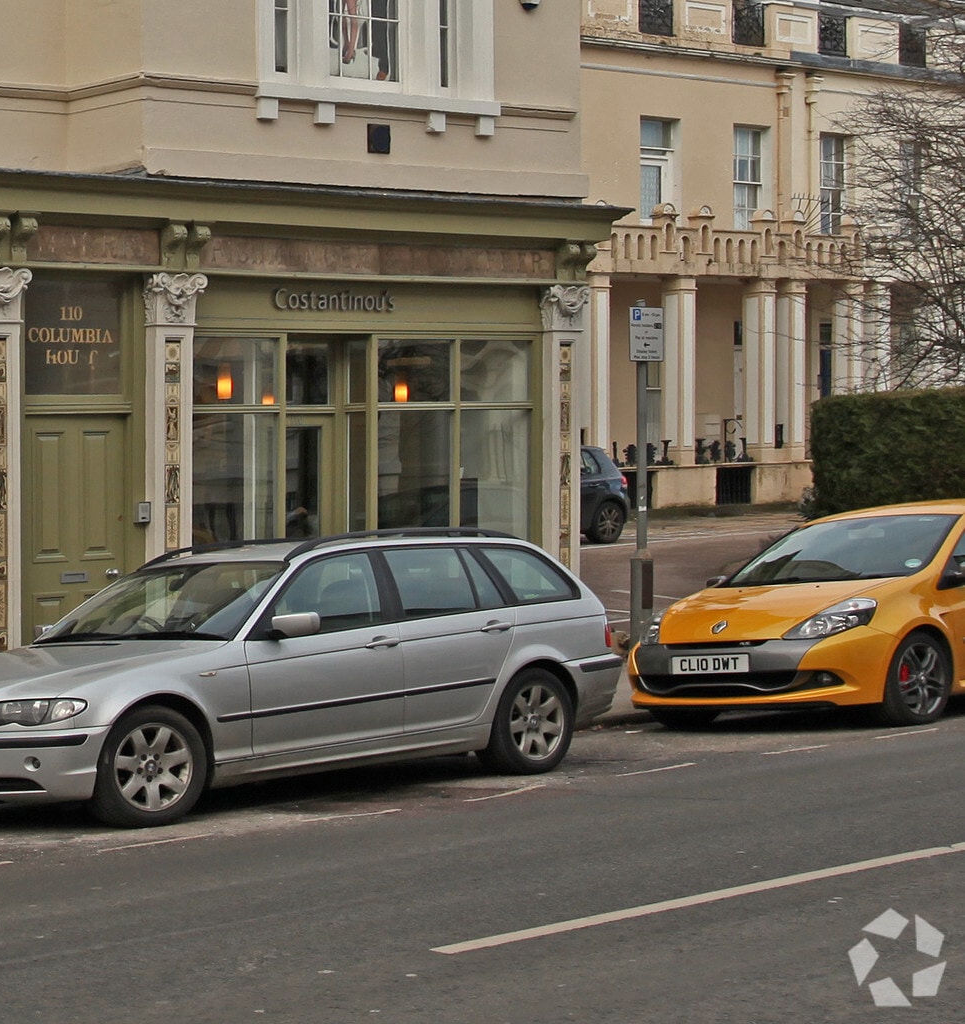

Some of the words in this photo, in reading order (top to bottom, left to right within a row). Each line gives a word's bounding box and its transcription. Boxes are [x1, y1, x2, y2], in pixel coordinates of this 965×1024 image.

[274, 288, 396, 312] Costantinou's
[60, 306, 83, 321] 110
[634, 309, 641, 320] P
[28, 327, 114, 344] COLUMBIA
[712, 657, 739, 671] DWT
